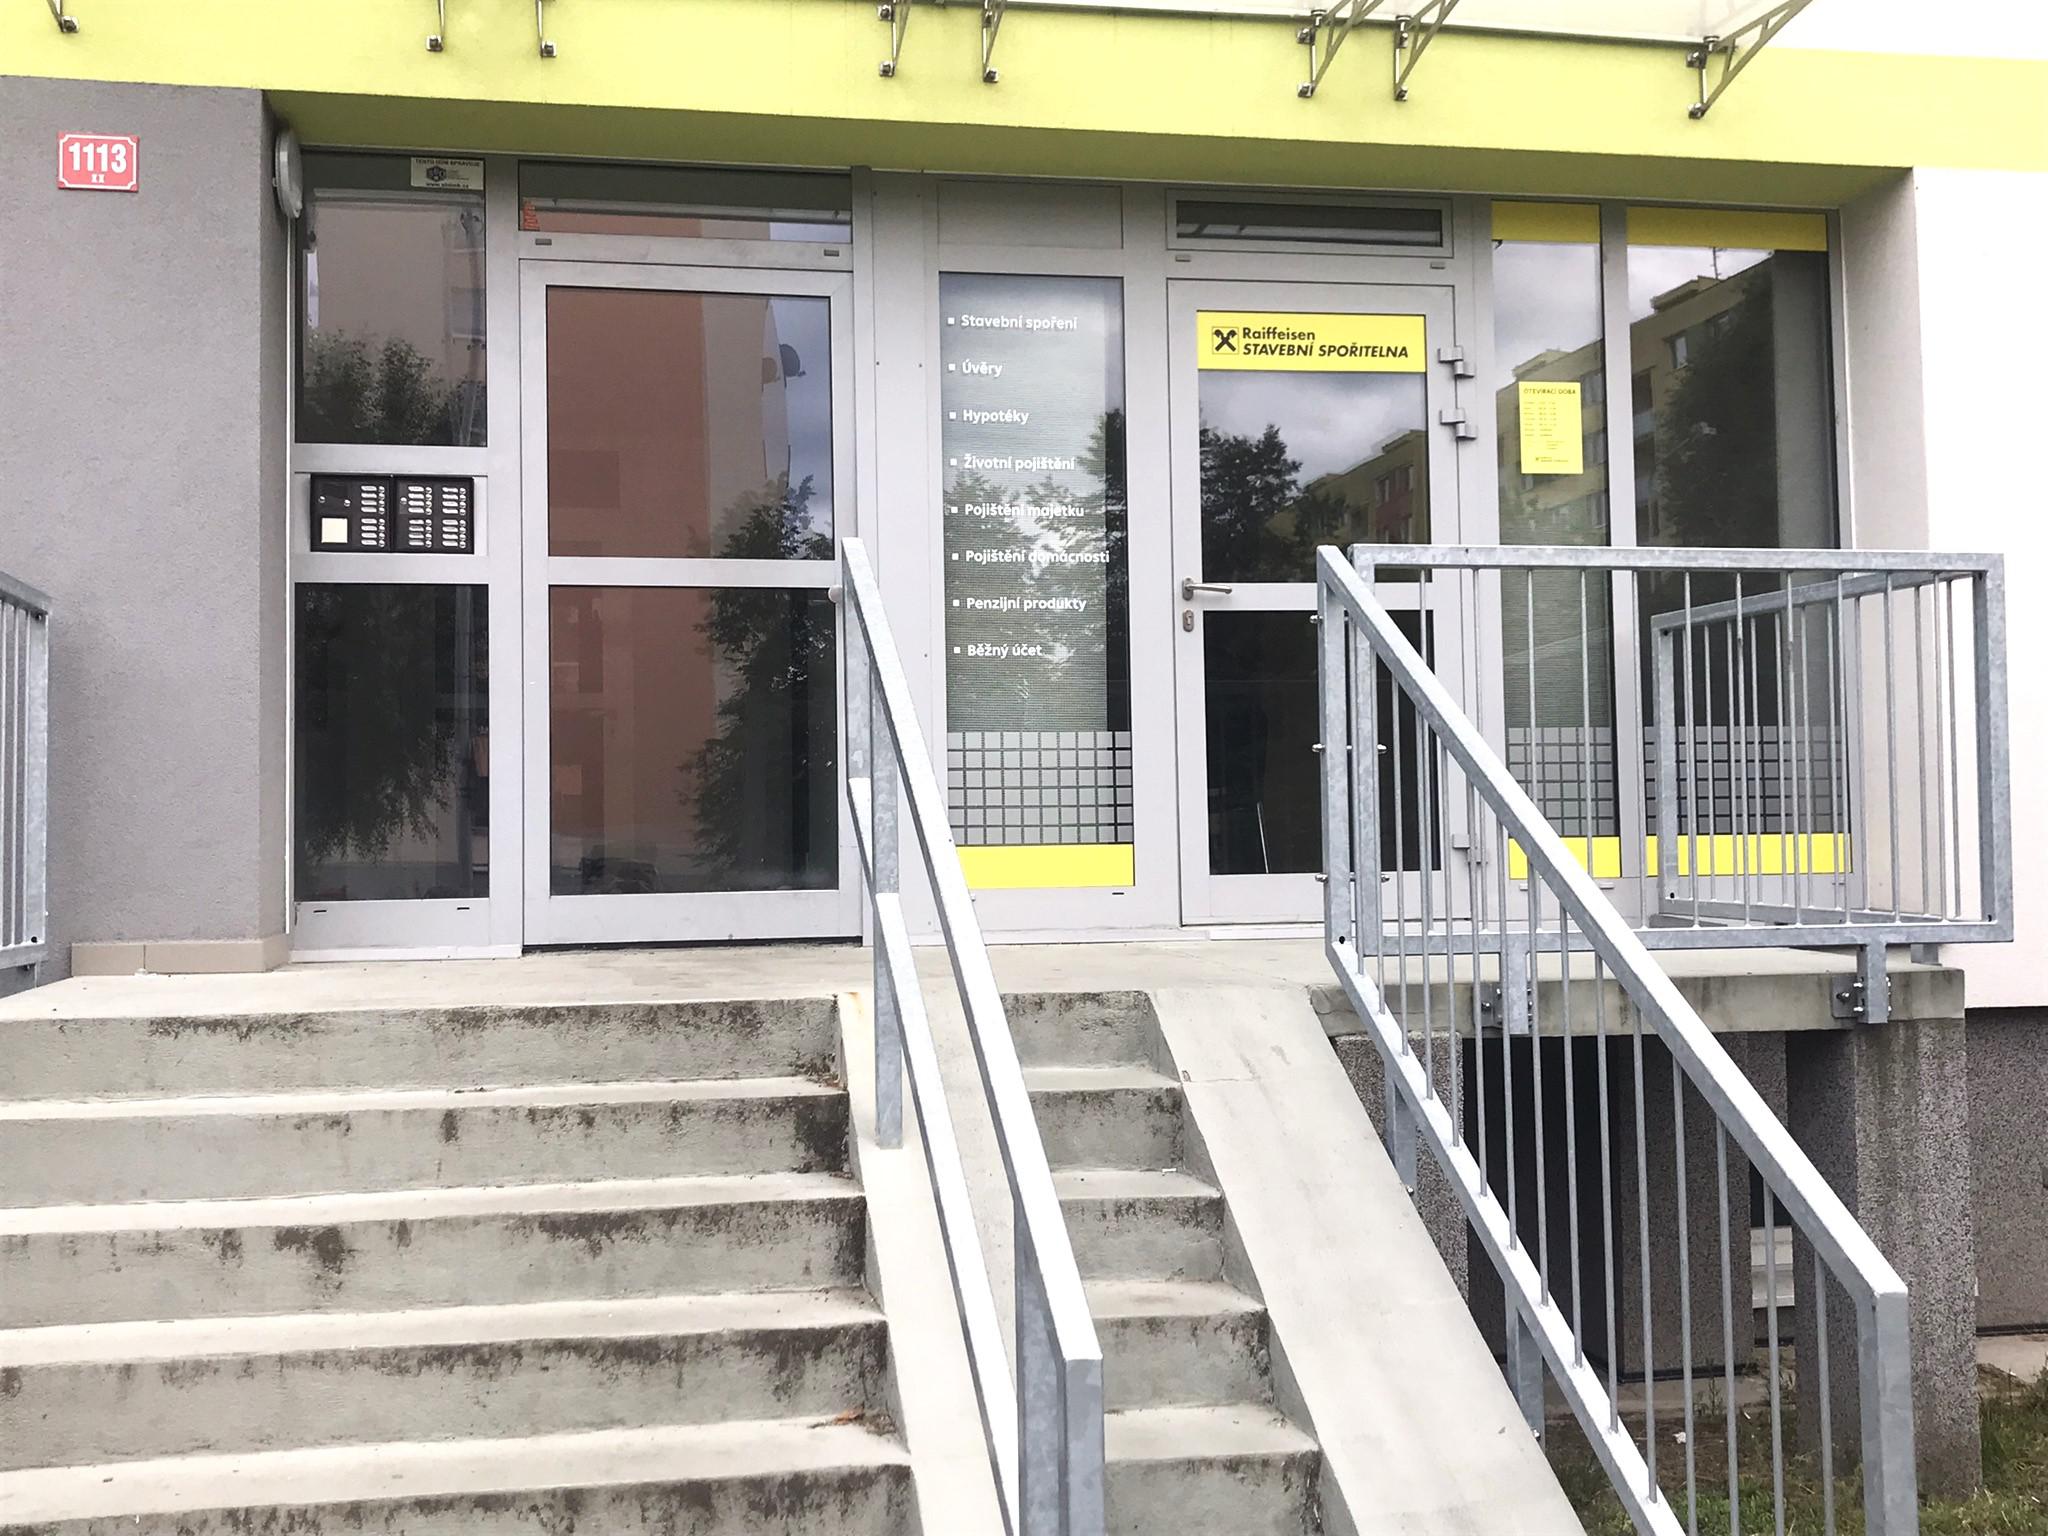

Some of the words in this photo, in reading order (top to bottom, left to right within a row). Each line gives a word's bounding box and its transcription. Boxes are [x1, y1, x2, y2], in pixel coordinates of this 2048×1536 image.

[68, 141, 127, 173] 1113
[961, 314, 1023, 328] Stavební
[1025, 316, 1078, 331] spoření
[1242, 327, 1315, 341] Raiffeisen
[1243, 342, 1314, 357] STAVEBNÍ
[1318, 342, 1409, 358] SPOŘITELNA
[962, 359, 1003, 377] Úvěry
[963, 409, 1029, 424] Hypotéky
[964, 453, 1012, 469] Životní
[1015, 455, 1075, 472] pojištění
[965, 503, 1024, 518] Pojištění
[1027, 504, 1085, 518] majetku
[966, 549, 1025, 565] Pojištění
[1028, 550, 1110, 564] domácnosti
[966, 597, 1020, 612] Penzijní
[1023, 597, 1087, 612] produkty
[967, 643, 1009, 659] Běžný
[1012, 644, 1042, 656] účet
